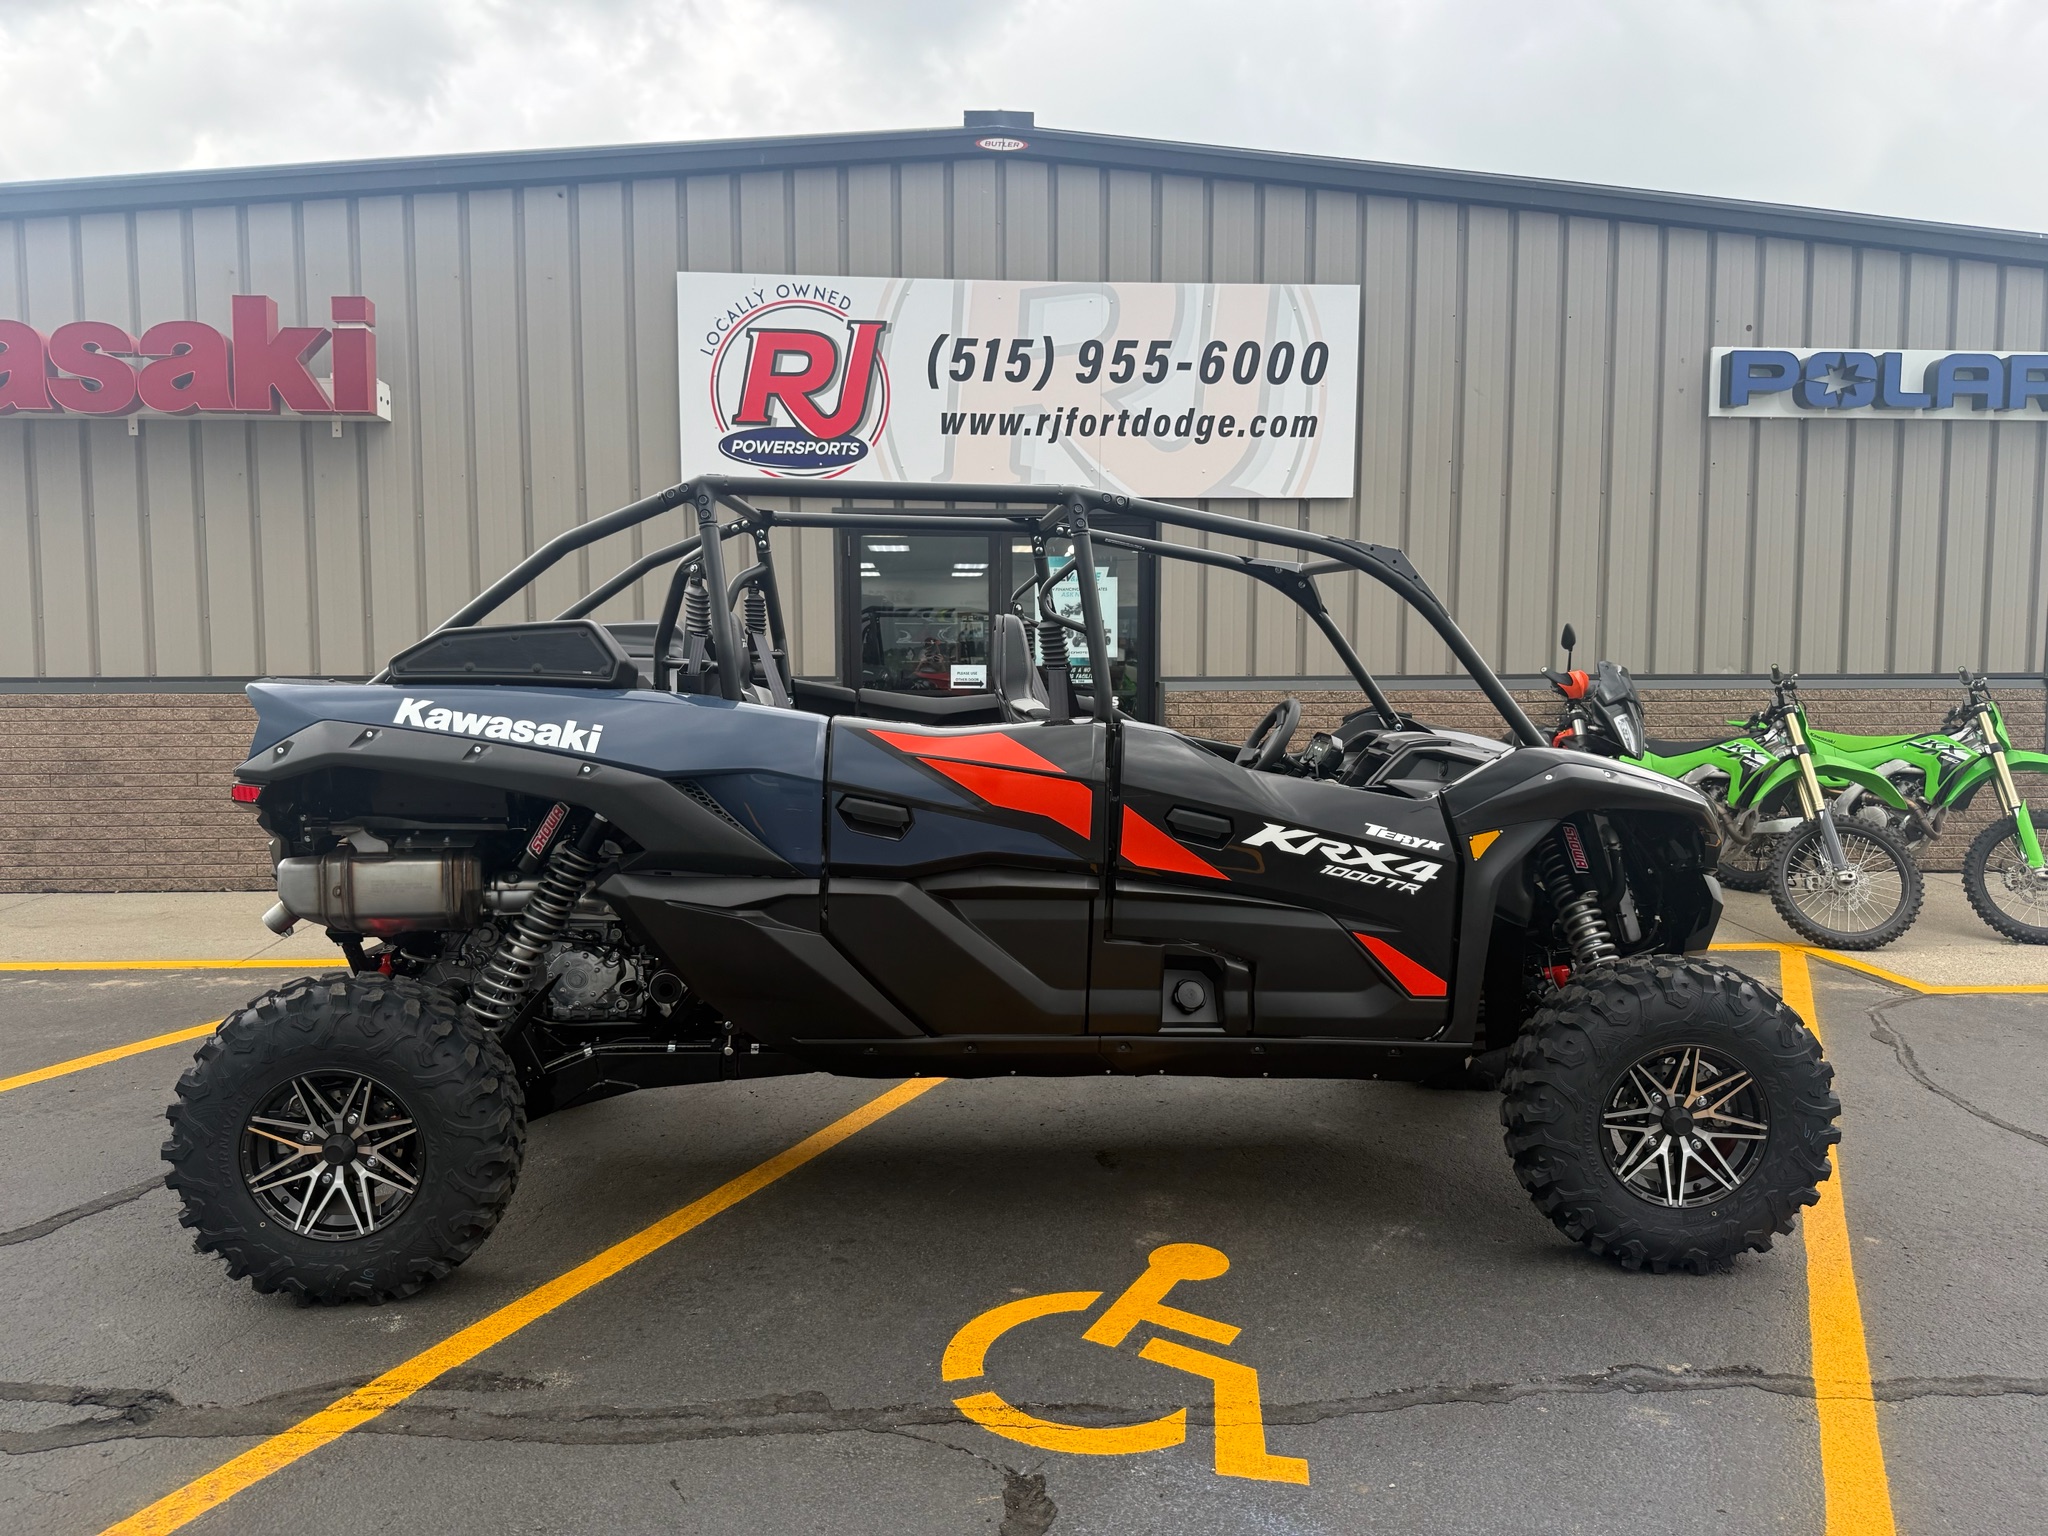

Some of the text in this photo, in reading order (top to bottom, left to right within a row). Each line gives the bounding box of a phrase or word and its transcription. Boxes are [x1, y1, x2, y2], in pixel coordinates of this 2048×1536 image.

[700, 283, 852, 356] LOCALLY OWNED
[731, 320, 890, 441] RJ
[927, 333, 1330, 392] (515) 955-6000
[731, 440, 861, 456] POWERSPORTS
[940, 406, 1319, 445] www.rjfortdodge.com
[393, 697, 604, 754] Kawasaki
[531, 804, 565, 855] SHOWA
[1241, 822, 1443, 883] KRX4
[1364, 822, 1445, 851] TERYX
[1563, 826, 1589, 869] SHOWA
